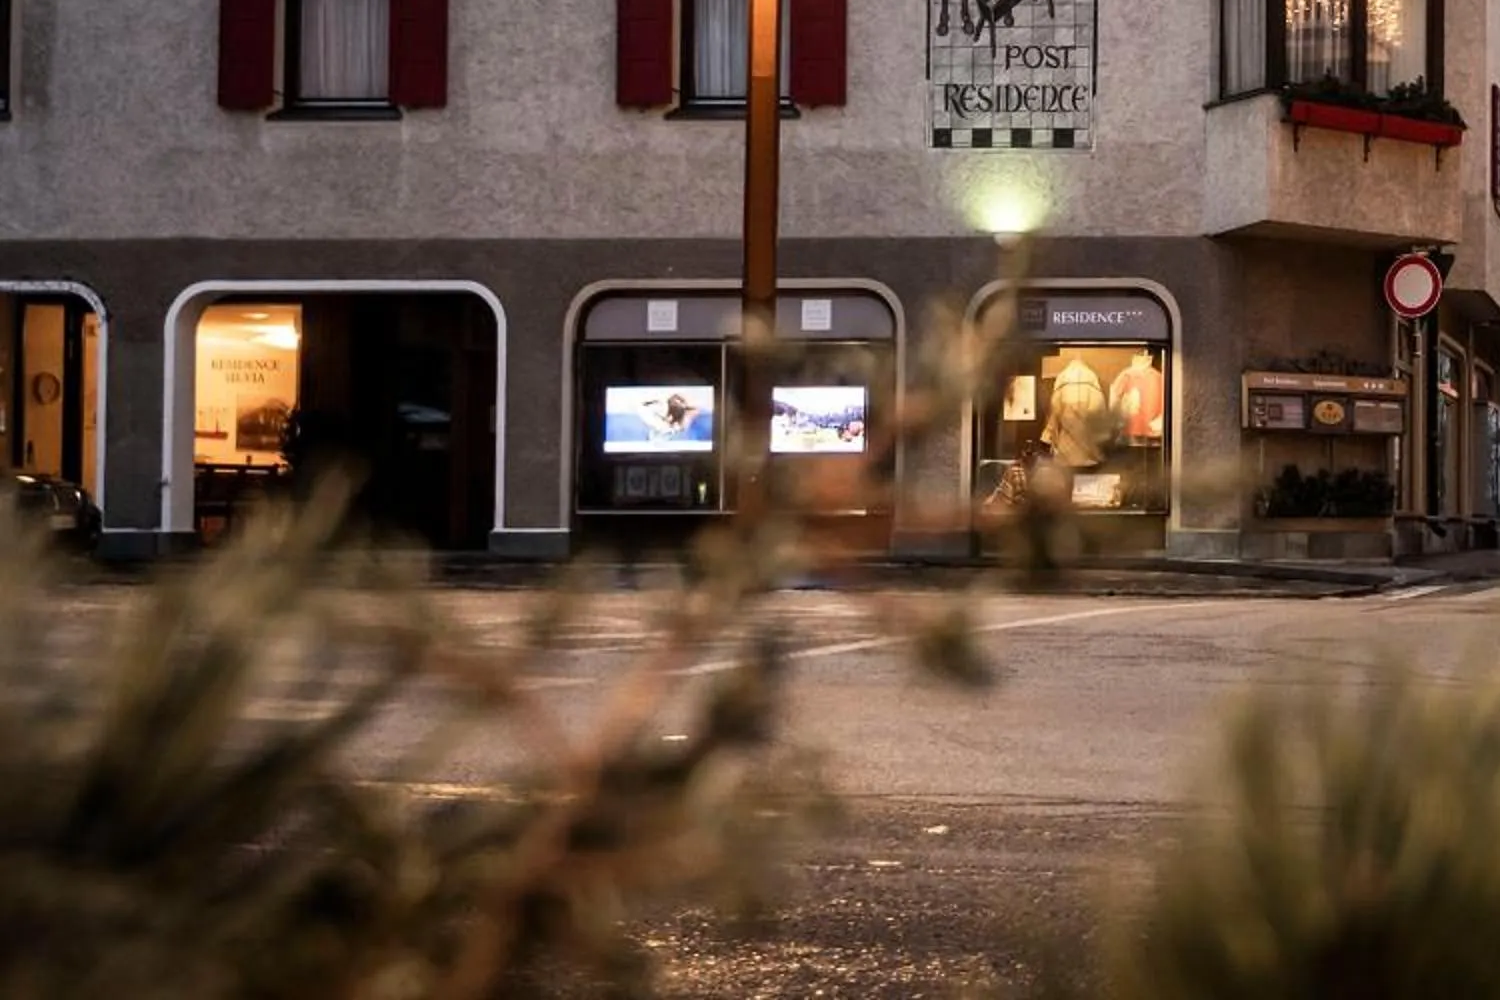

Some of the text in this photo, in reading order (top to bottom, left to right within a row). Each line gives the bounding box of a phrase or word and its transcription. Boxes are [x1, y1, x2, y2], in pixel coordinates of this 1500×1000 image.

[1005, 45, 1075, 70] POST
[943, 83, 1089, 119] RESIDENCE
[1053, 311, 1124, 324] RESIDENCE
